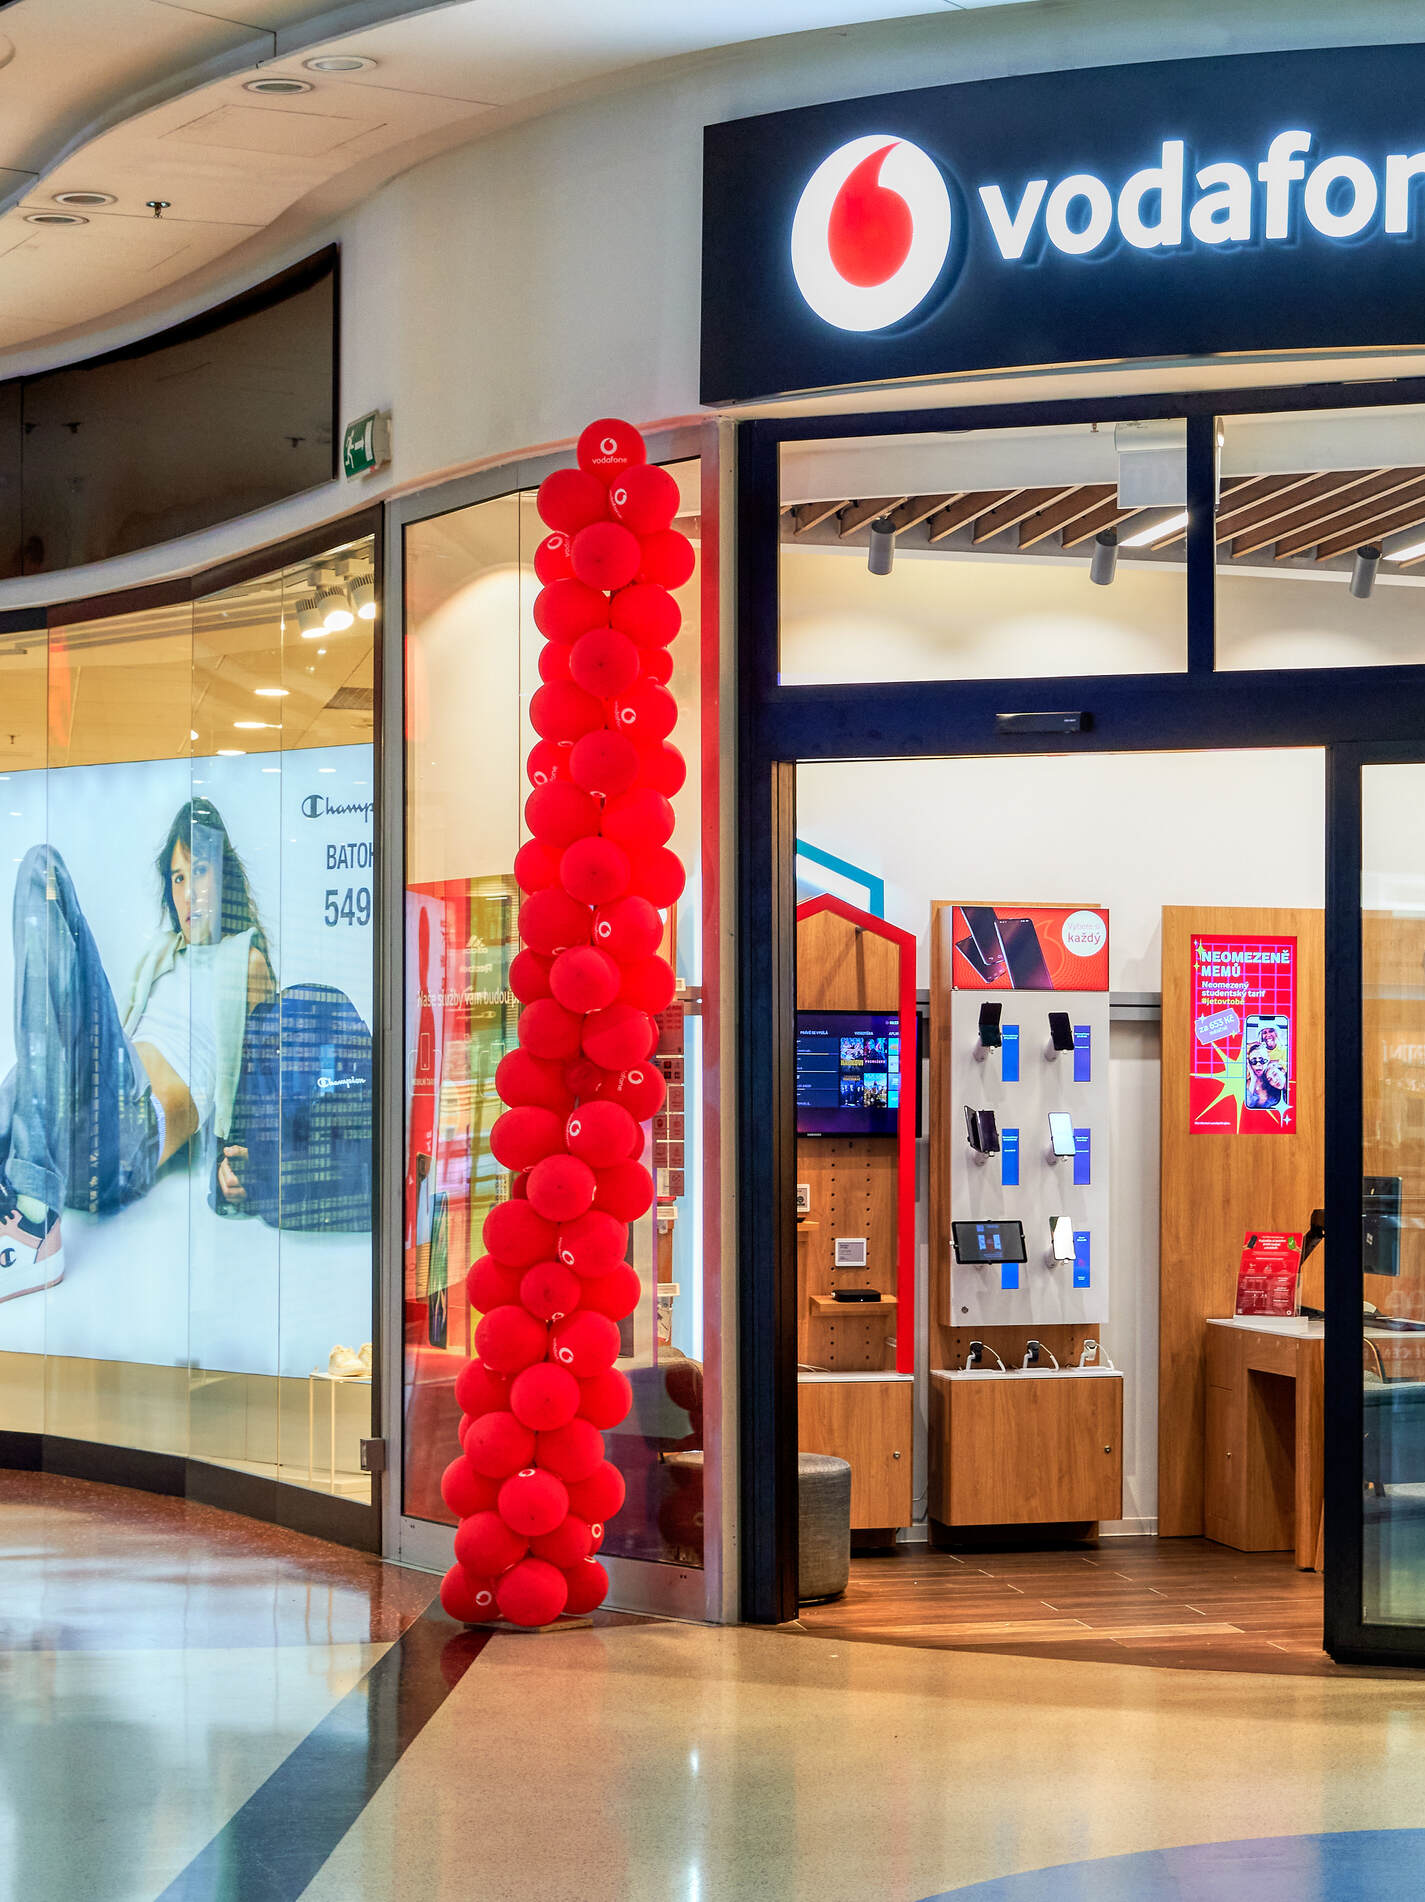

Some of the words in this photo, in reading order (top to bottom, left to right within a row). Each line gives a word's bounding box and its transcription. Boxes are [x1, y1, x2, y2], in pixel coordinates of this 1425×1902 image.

[592, 456, 627, 464] vodafone
[324, 887, 371, 927] 549
[1067, 931, 1101, 945] každý
[1201, 949, 1290, 964] NEOMEZENĚ
[1201, 962, 1241, 977] MEMŮ
[1201, 981, 1249, 990] Neomezený
[1201, 990, 1247, 999] studentský
[317, 1075, 366, 1089] Champion
